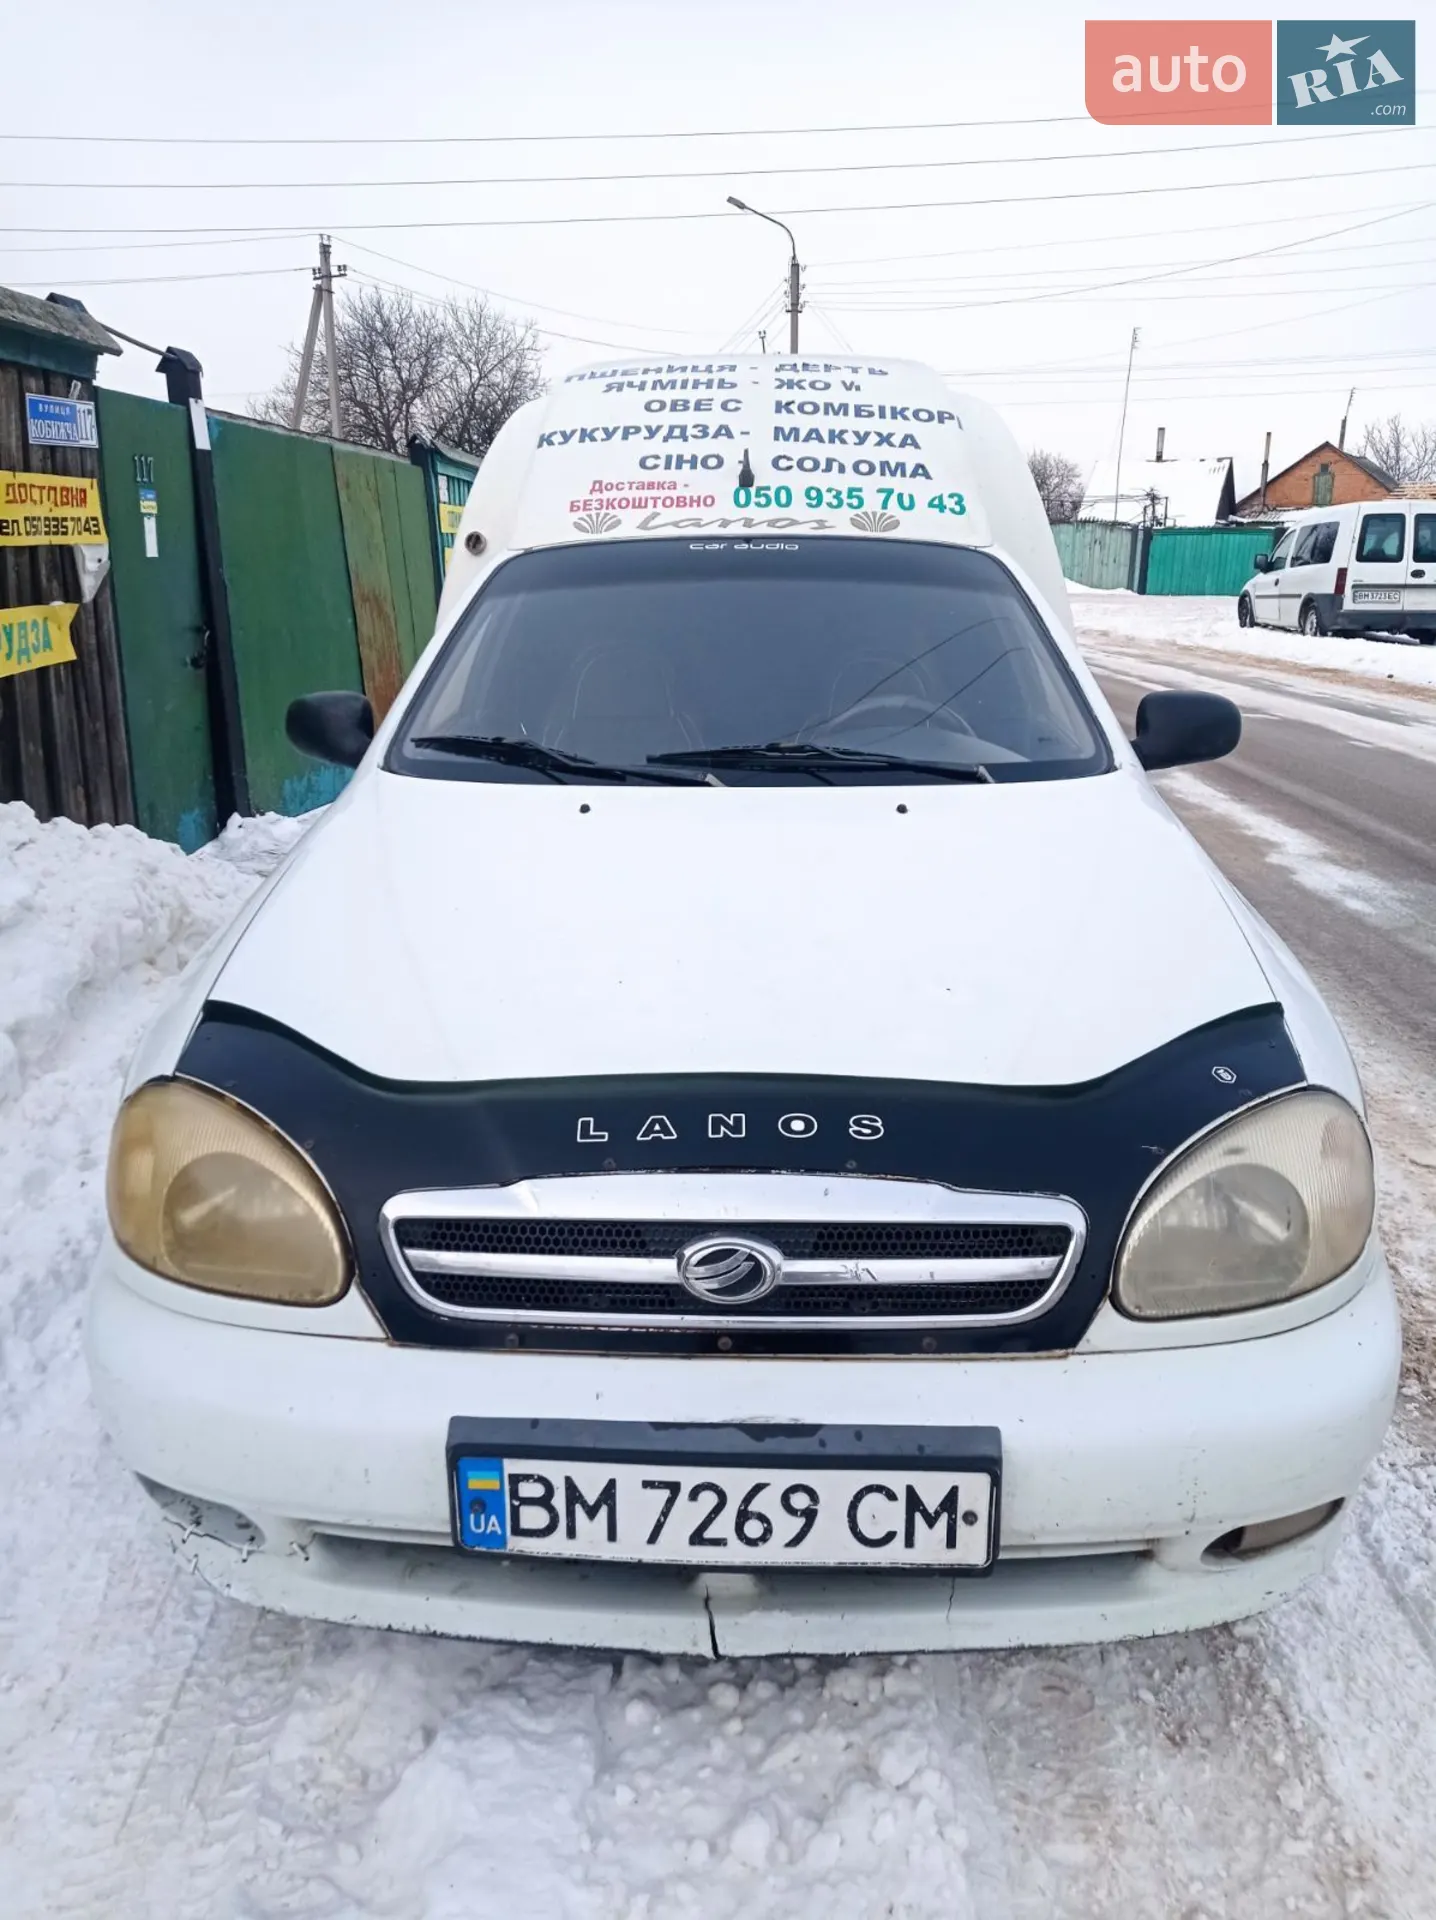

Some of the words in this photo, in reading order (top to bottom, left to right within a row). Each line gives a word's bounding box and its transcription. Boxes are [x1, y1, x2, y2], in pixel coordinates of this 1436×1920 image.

[564, 364, 738, 384] ПШЕНИЦЯ
[602, 378, 738, 393] ЯЧМІНЬ
[643, 398, 743, 413] ОВЕС
[773, 400, 964, 431] КОМБІКОР
[773, 426, 922, 450] МАКУХА
[638, 453, 725, 471] СІНО
[771, 454, 934, 480] СОЛОМА
[589, 480, 678, 495] Доставка
[569, 494, 716, 513] БЕЗКОШТОВНО
[733, 485, 793, 509] 050
[804, 486, 865, 510] 935
[876, 488, 916, 511] 70
[927, 492, 967, 515] 43
[689, 542, 728, 550] car
[733, 542, 799, 551] audio
[0, 616, 53, 666] УДЗА
[576, 1113, 885, 1143] LANOS
[507, 1472, 618, 1543] BM
[641, 1479, 821, 1549] 7269
[846, 1483, 960, 1550] CM
[469, 1513, 502, 1535] UA
